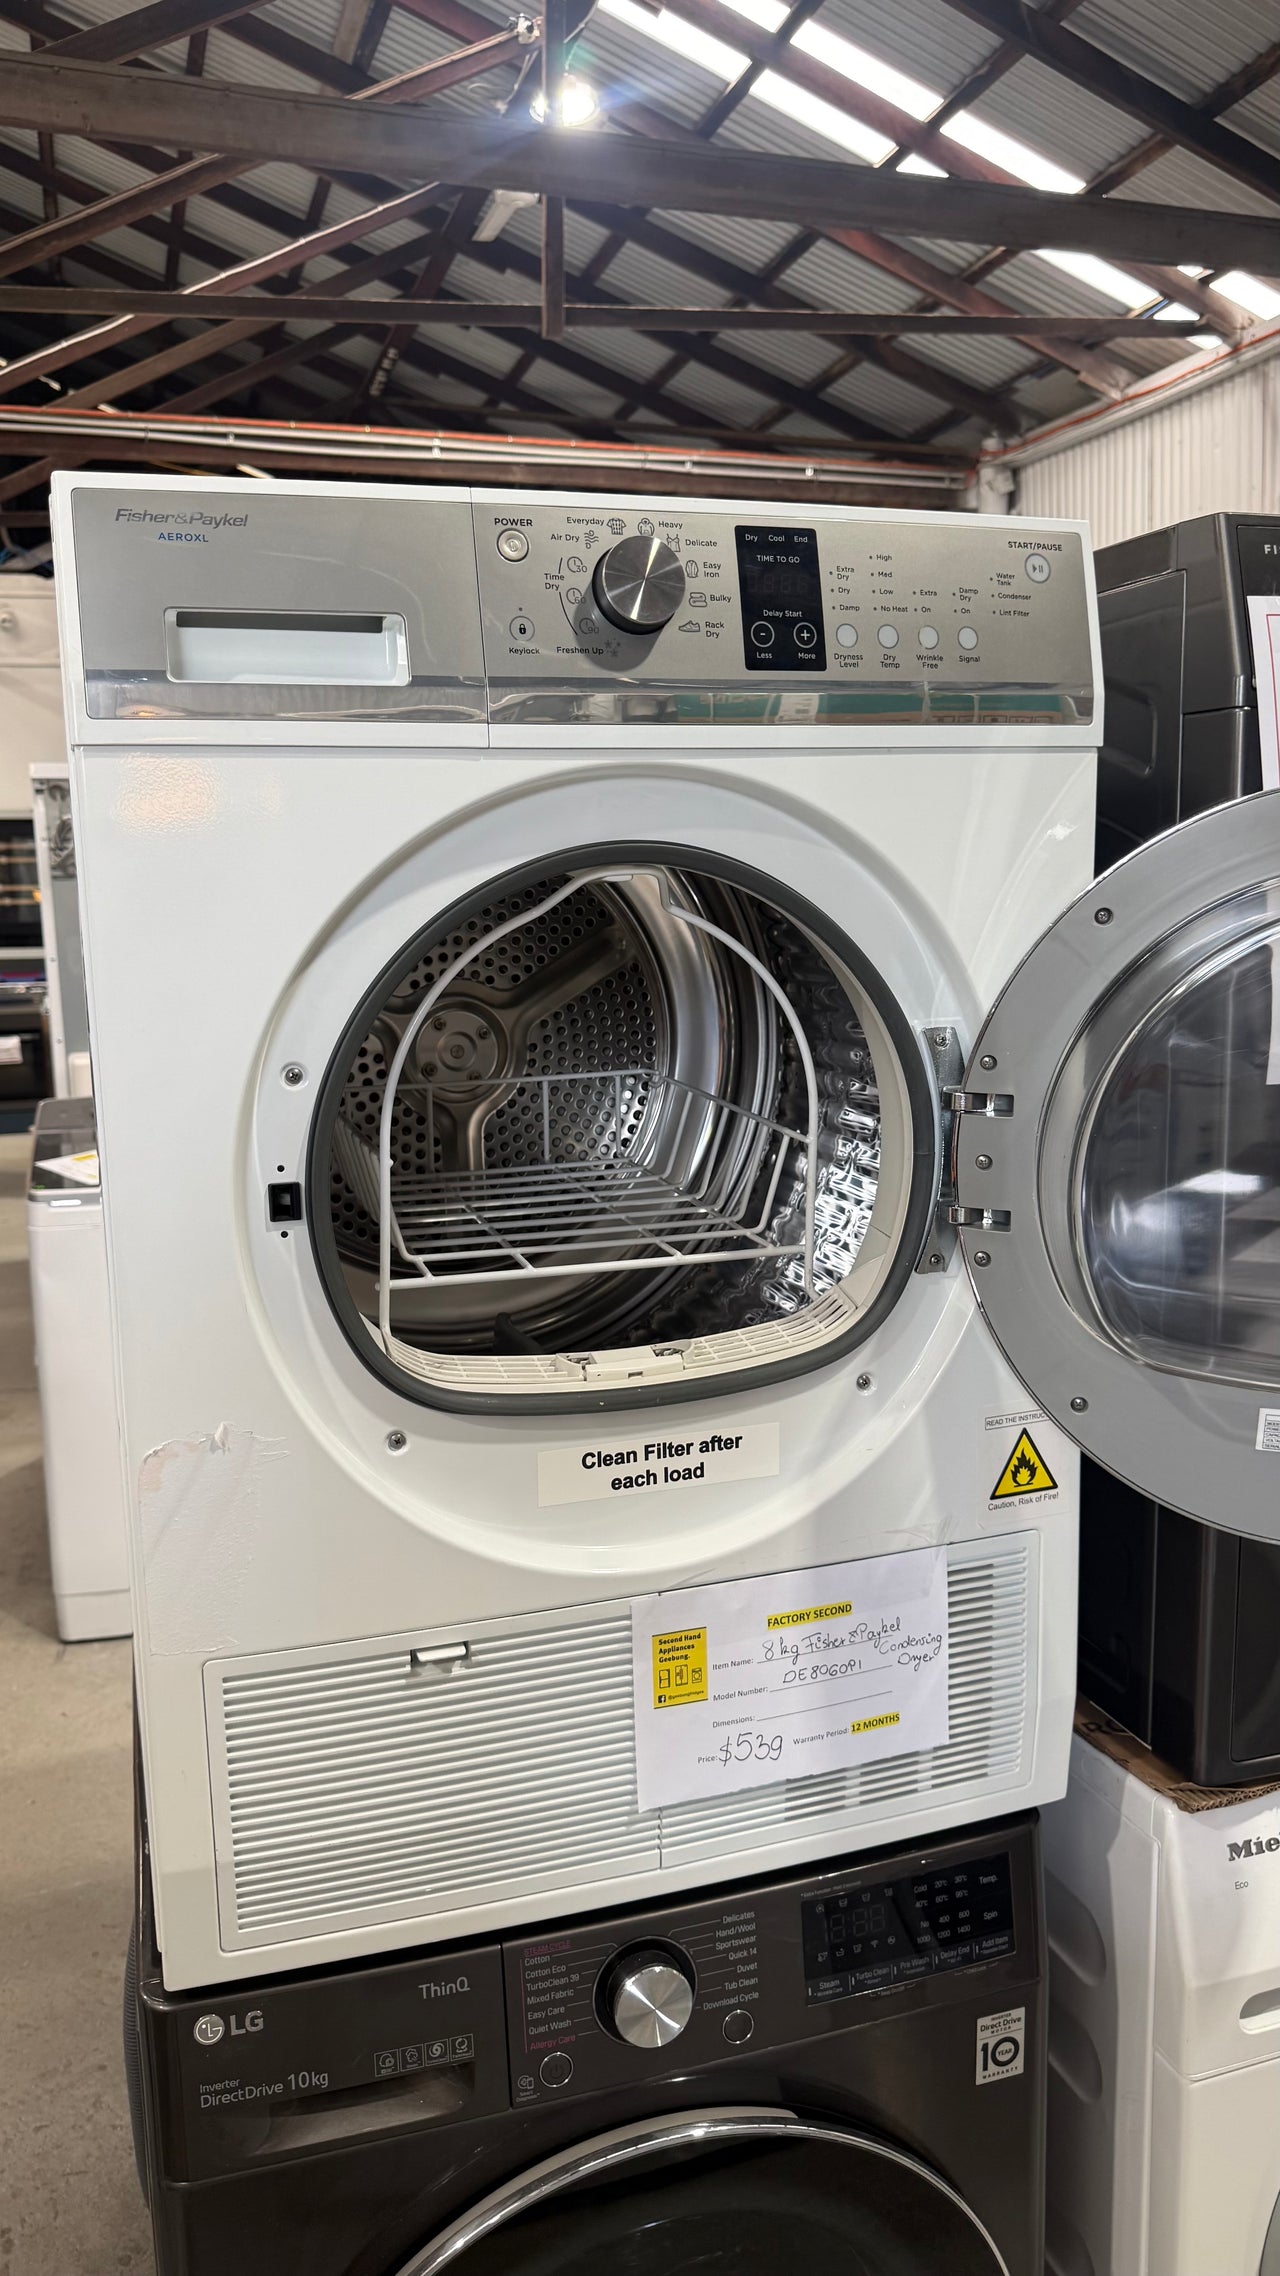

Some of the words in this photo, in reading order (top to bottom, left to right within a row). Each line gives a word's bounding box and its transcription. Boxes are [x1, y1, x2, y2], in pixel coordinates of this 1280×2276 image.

[115, 508, 248, 529] Fisher&Paykel
[494, 518, 533, 527] POWER
[567, 517, 605, 526] Everyday
[658, 521, 683, 530] Heavy
[158, 532, 209, 542] AEROXL
[566, 534, 580, 543] Dry
[745, 534, 759, 542] Dry
[768, 534, 785, 542] Cool
[685, 539, 718, 547] Delicate
[1008, 541, 1063, 551] START/PAUSE
[1264, 544, 1280, 555] FI
[756, 554, 775, 563] TIME
[776, 555, 787, 563] TO
[876, 554, 893, 562] High
[576, 565, 587, 573] 30
[703, 562, 721, 571] Easy
[544, 573, 565, 581] Time
[836, 573, 850, 581] Dry
[996, 572, 1016, 580] Water
[545, 582, 560, 591] Dry
[838, 587, 850, 595] Dry
[959, 587, 979, 595] Damp
[920, 589, 938, 597] Extra
[959, 594, 972, 602] Dry
[997, 593, 1032, 601] Condenser
[710, 594, 732, 603] Bulky
[839, 604, 860, 613] Damp
[960, 607, 971, 615] On
[763, 610, 783, 618] Delay
[588, 626, 599, 634] 90
[705, 621, 724, 629] Rack
[706, 630, 720, 638] Dry
[509, 647, 540, 655] Keylock
[556, 646, 586, 654] Freshen
[588, 647, 604, 655] Up
[834, 653, 864, 661] Dryness
[883, 654, 897, 662] Dry
[916, 654, 944, 662] Wrinkle
[958, 655, 981, 663] Signal
[880, 661, 900, 669] Temp
[986, 1419, 1004, 1427] READ
[1005, 1416, 1018, 1424] THE
[1018, 1412, 1047, 1421] INSTRUC
[581, 1450, 638, 1469] Clean
[644, 1441, 694, 1461] Filter
[699, 1435, 743, 1453] after
[611, 1469, 658, 1491] each
[664, 1462, 705, 1483] load
[988, 1501, 1017, 1511] Caution,
[1018, 1496, 1034, 1505] Risk
[1035, 1495, 1042, 1503] of
[1043, 1491, 1059, 1501] Fire!
[767, 1612, 811, 1627] FACTORY
[814, 1604, 852, 1619] SECOND
[658, 1635, 683, 1645] Second
[684, 1633, 701, 1641] Hand
[879, 1633, 943, 1655] Condensing
[659, 1644, 695, 1655] Appliances
[762, 1640, 775, 1661] 8
[801, 1632, 846, 1653] Fisher
[659, 1654, 691, 1663] Geebung.
[712, 1662, 730, 1671] Item
[731, 1658, 754, 1668] Name:
[712, 1692, 736, 1702] Model
[737, 1686, 769, 1697] Number:
[712, 1715, 756, 1728] Dimensions:
[697, 1755, 718, 1764] Price:
[793, 1733, 825, 1746] Warranty
[826, 1728, 850, 1738] Period:
[851, 1723, 861, 1732] 12
[863, 1713, 901, 1729] MONTHS
[1227, 1832, 1280, 1861] Mie
[914, 1884, 928, 1893] Cold
[979, 1874, 999, 1885] Temp.
[1235, 1881, 1249, 1890] Eco
[722, 1911, 756, 1924] Delicates
[983, 1911, 998, 1921] Spin
[716, 1923, 756, 1938] Hand/Wool
[716, 1935, 757, 1950] Sportswear
[916, 1935, 931, 1944] 1000
[982, 1939, 995, 1948] Add
[728, 1949, 749, 1960] Quick
[750, 1947, 757, 1955] 14
[940, 1949, 957, 1960] Delay
[958, 1946, 970, 1954] End
[525, 1955, 550, 1966] Cotton
[912, 1956, 930, 1968] Wash
[525, 1968, 551, 1980] Cotton
[552, 1964, 566, 1974] Eco
[737, 1962, 758, 1973] Duvet
[856, 1971, 873, 1981] Turbo
[873, 1967, 889, 1976] Clean
[418, 1976, 470, 1999] ThinQ
[526, 1977, 569, 1991] TurboClean
[570, 1974, 580, 1982] 39
[724, 1982, 738, 1991] Tub
[738, 1977, 758, 1987] Clean
[819, 1979, 840, 1990] Steam
[527, 1994, 550, 2005] Mixed
[551, 1988, 575, 2000] Fabric
[703, 1997, 739, 2011] Download
[739, 1992, 760, 2002] Cycle
[528, 2009, 546, 2020] Easy
[547, 2006, 565, 2015] Care
[229, 2010, 264, 2036] LG
[528, 2024, 549, 2035] Quiet
[550, 2019, 572, 2031] Wash
[980, 2021, 1002, 2033] Direct
[1003, 2016, 1022, 2026] Drive
[991, 2026, 1012, 2034] MOTOR
[530, 2039, 557, 2050] Allergy
[558, 2035, 576, 2045] Care
[981, 2036, 1020, 2072] 10
[997, 2048, 1013, 2057] YEAR
[982, 2066, 1018, 2079] WARRANTY
[200, 2078, 240, 2093] Inverter
